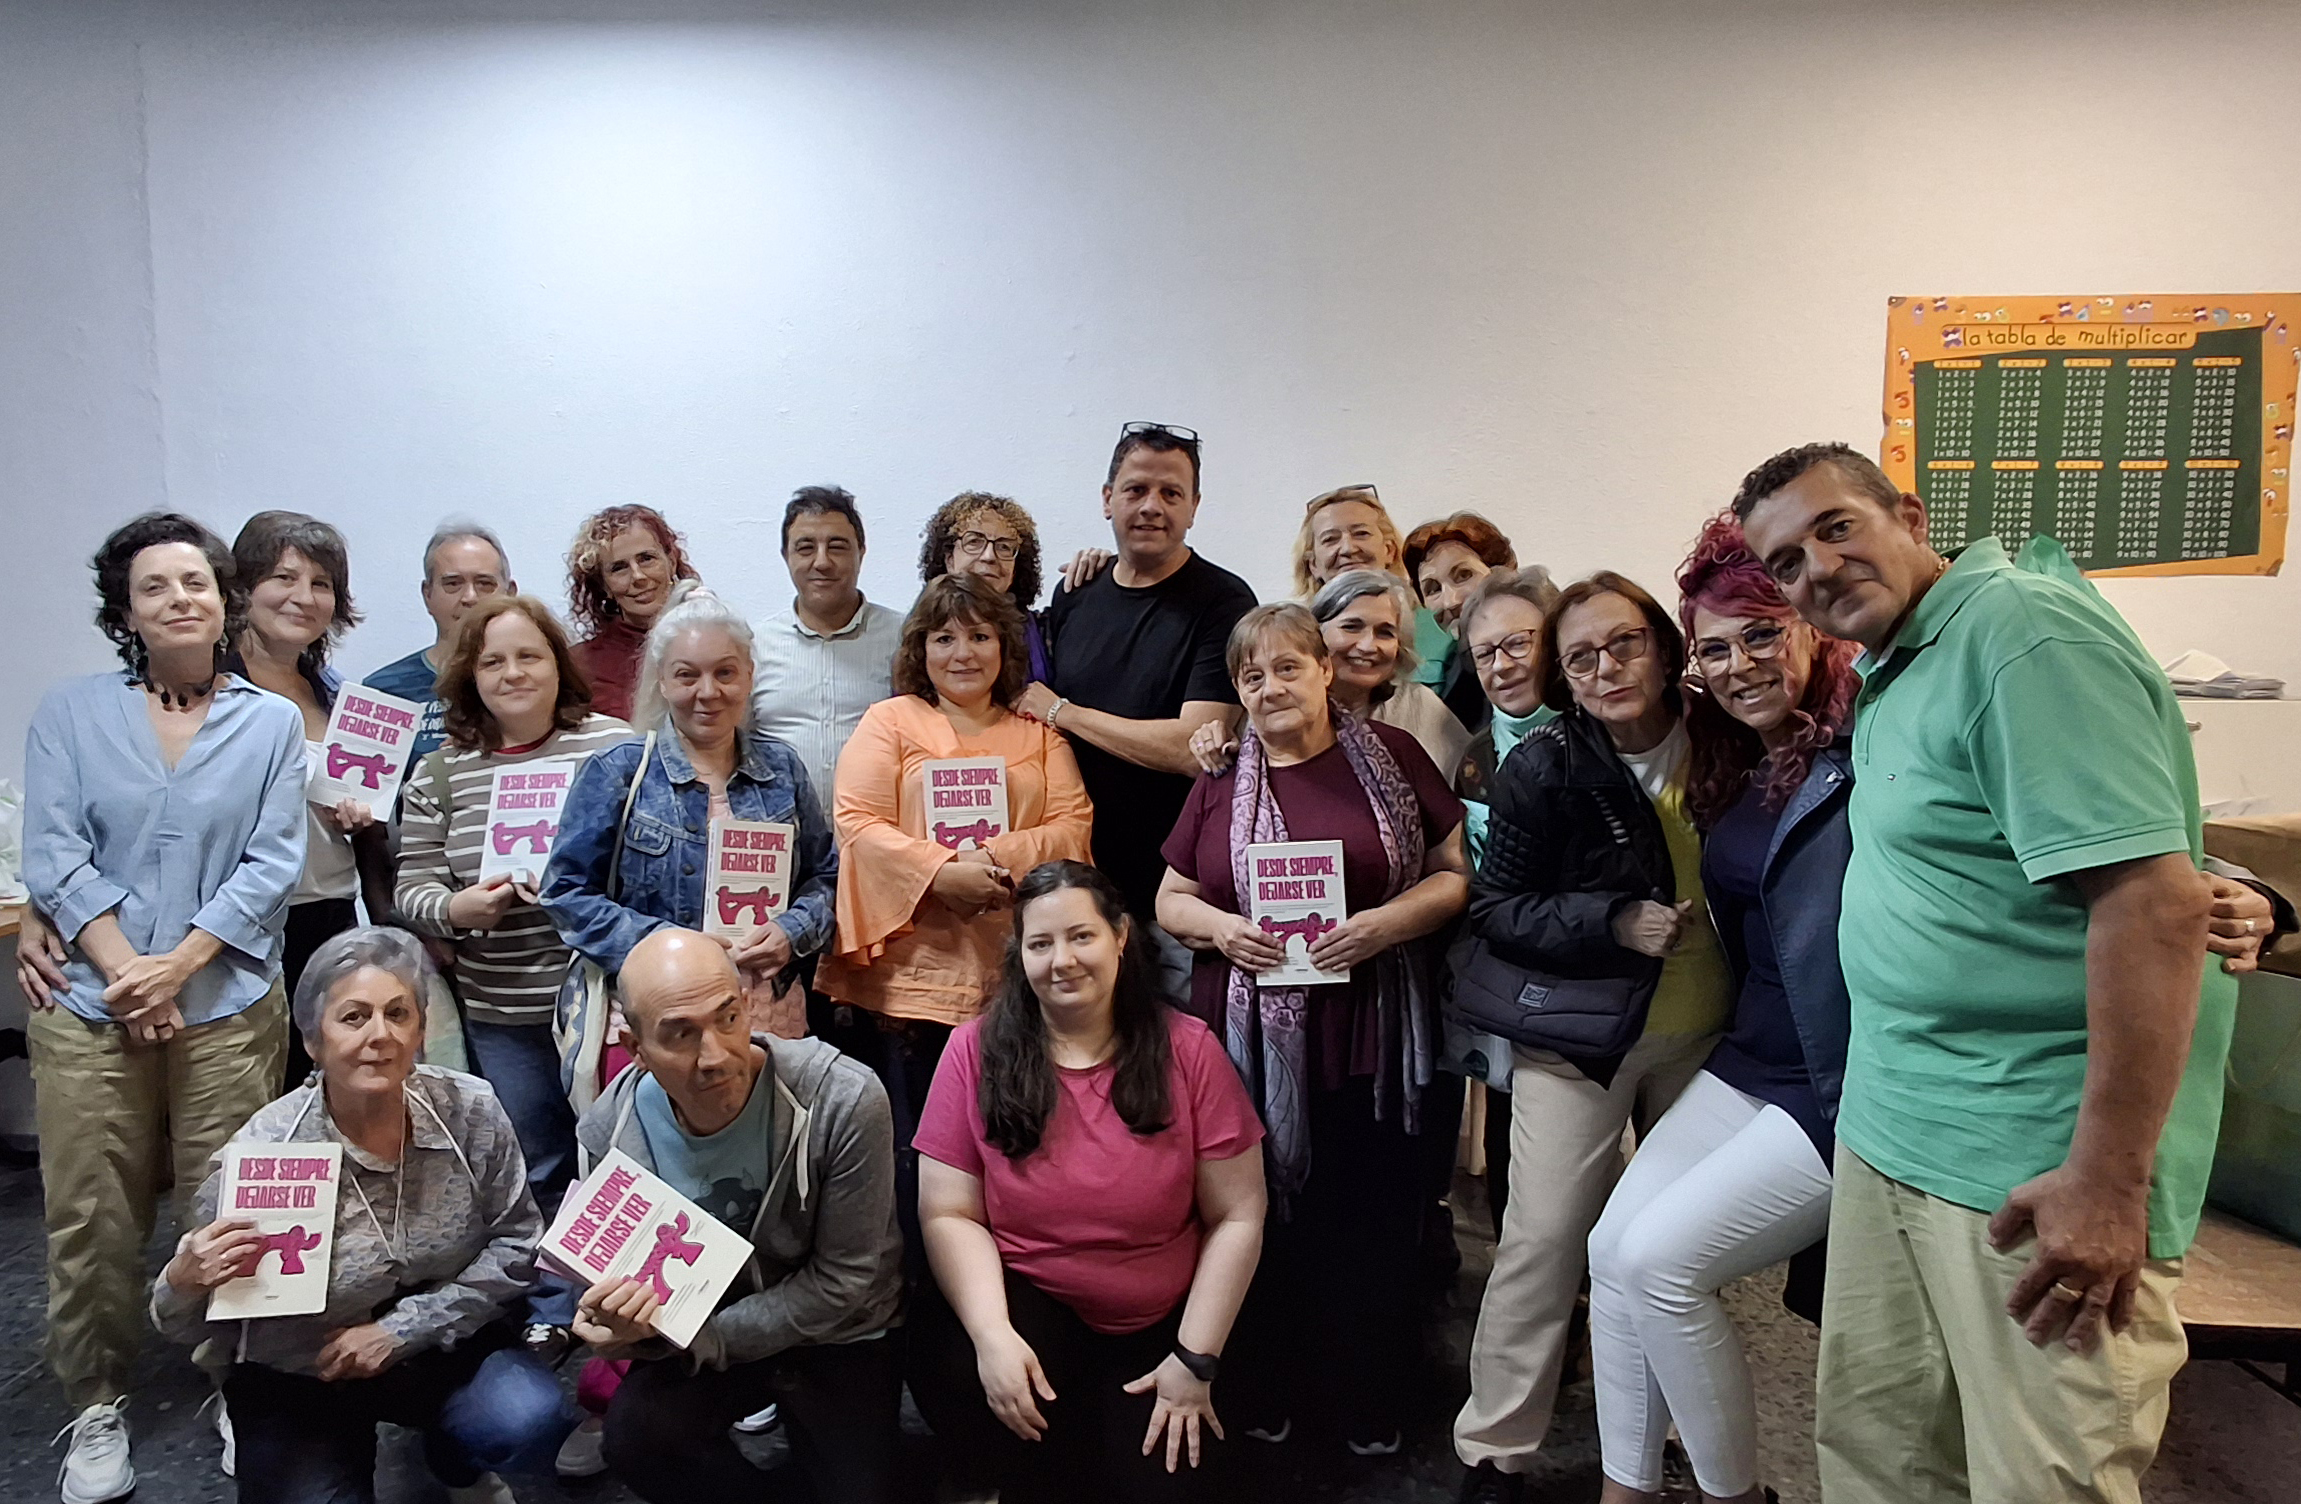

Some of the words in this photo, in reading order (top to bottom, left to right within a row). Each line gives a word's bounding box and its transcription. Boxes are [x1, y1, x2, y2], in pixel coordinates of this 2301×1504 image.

[1963, 325, 1980, 345] la
[1986, 324, 2036, 345] tabla
[2045, 326, 2066, 345] de
[2078, 325, 2187, 349] multiplicar
[932, 769, 960, 787] DESDE
[933, 790, 974, 808] DEJARSE
[975, 789, 992, 806] VER
[1257, 858, 1288, 877] DESDE
[1289, 856, 1338, 877] SIEMPRE,
[1259, 880, 1305, 900] DEJARSE
[1306, 880, 1326, 899] VER
[559, 1213, 603, 1256] DESDE
[586, 1165, 643, 1222] SIEMPRE,
[583, 1214, 637, 1274] DEJARSE
[620, 1192, 653, 1223] VER
